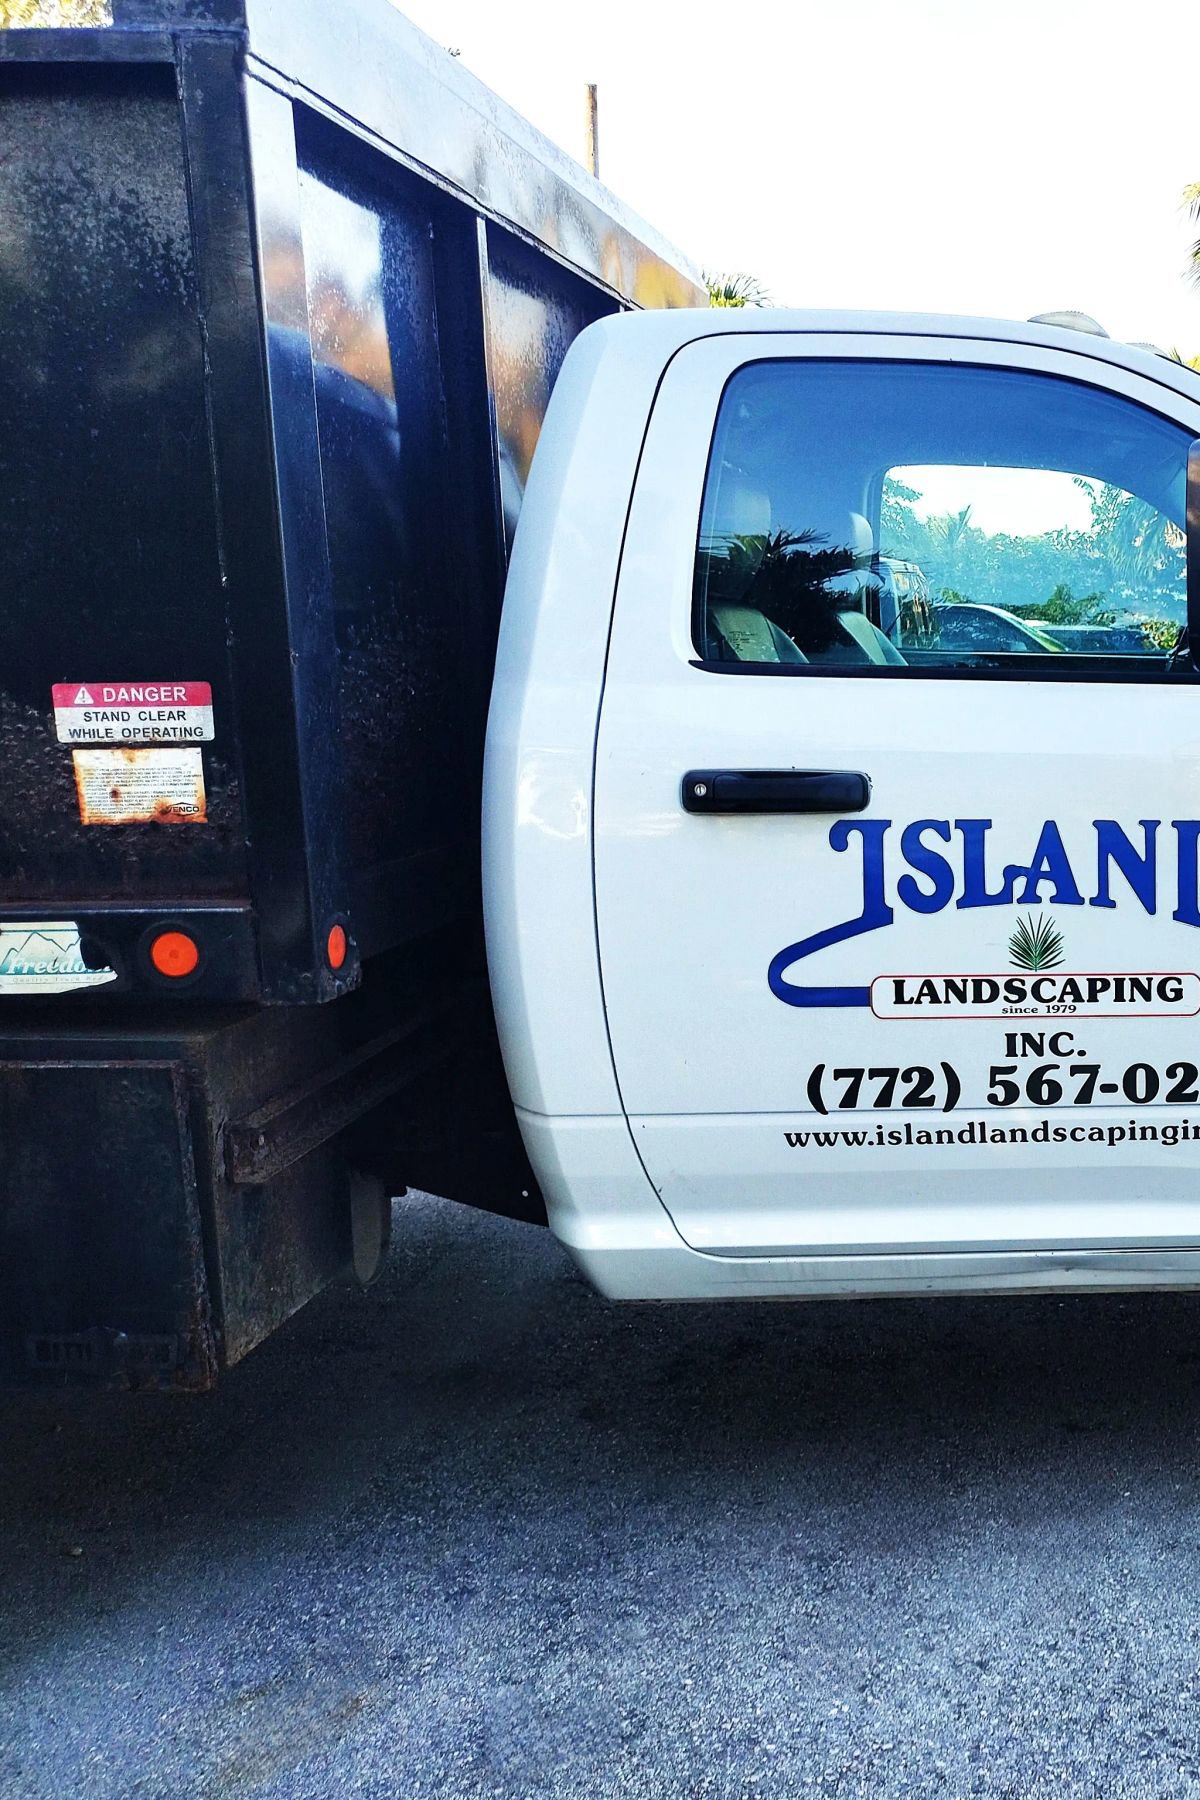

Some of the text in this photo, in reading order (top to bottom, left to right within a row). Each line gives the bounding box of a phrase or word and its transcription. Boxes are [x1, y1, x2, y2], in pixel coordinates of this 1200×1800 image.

[103, 686, 187, 702] DANGER
[83, 710, 187, 722] STAND CLEAR
[68, 725, 204, 739] WHILE OPERATING
[892, 977, 1184, 1004] LANDSCAPING
[1001, 1004, 1077, 1014] since 1979
[1004, 1032, 1087, 1057] INC.
[806, 1062, 961, 1115] (772)
